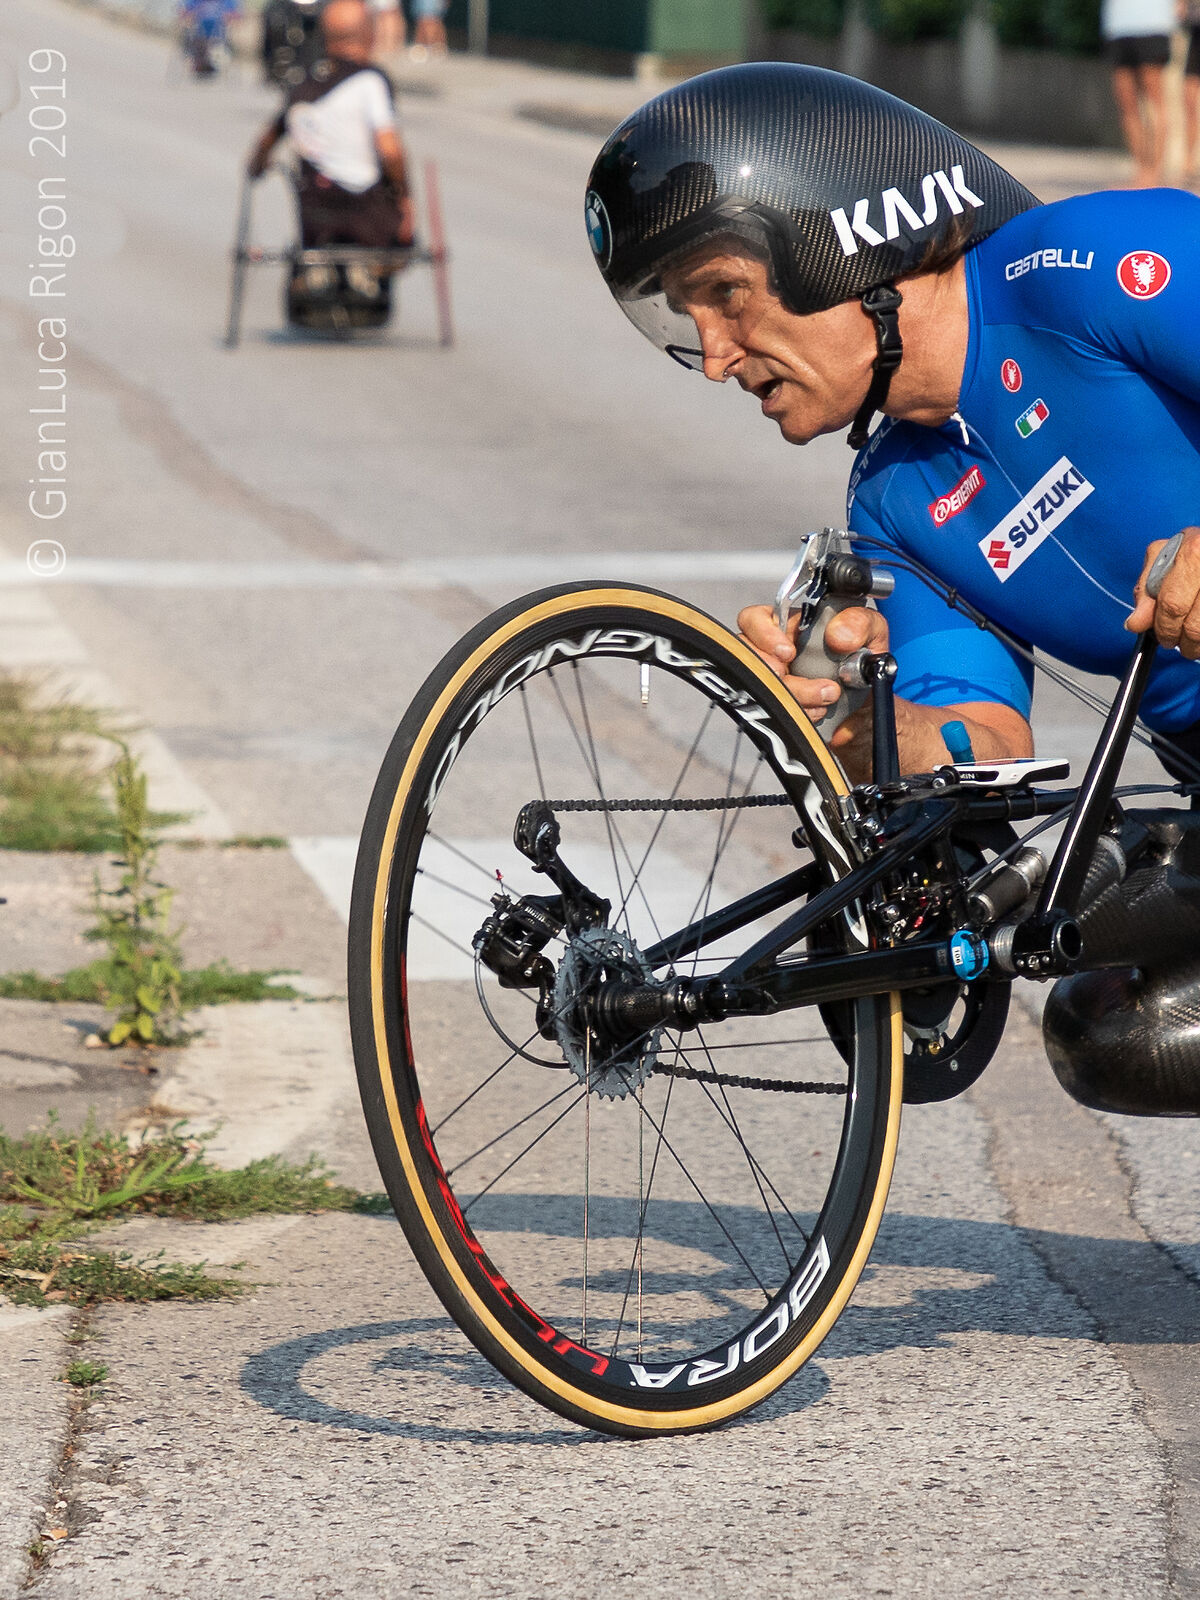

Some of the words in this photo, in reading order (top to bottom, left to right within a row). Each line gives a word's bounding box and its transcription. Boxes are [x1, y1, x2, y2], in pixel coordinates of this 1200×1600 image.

[830, 164, 985, 257] KASK
[1008, 466, 1086, 549] SUZUKI
[630, 1235, 831, 1389] BORA
